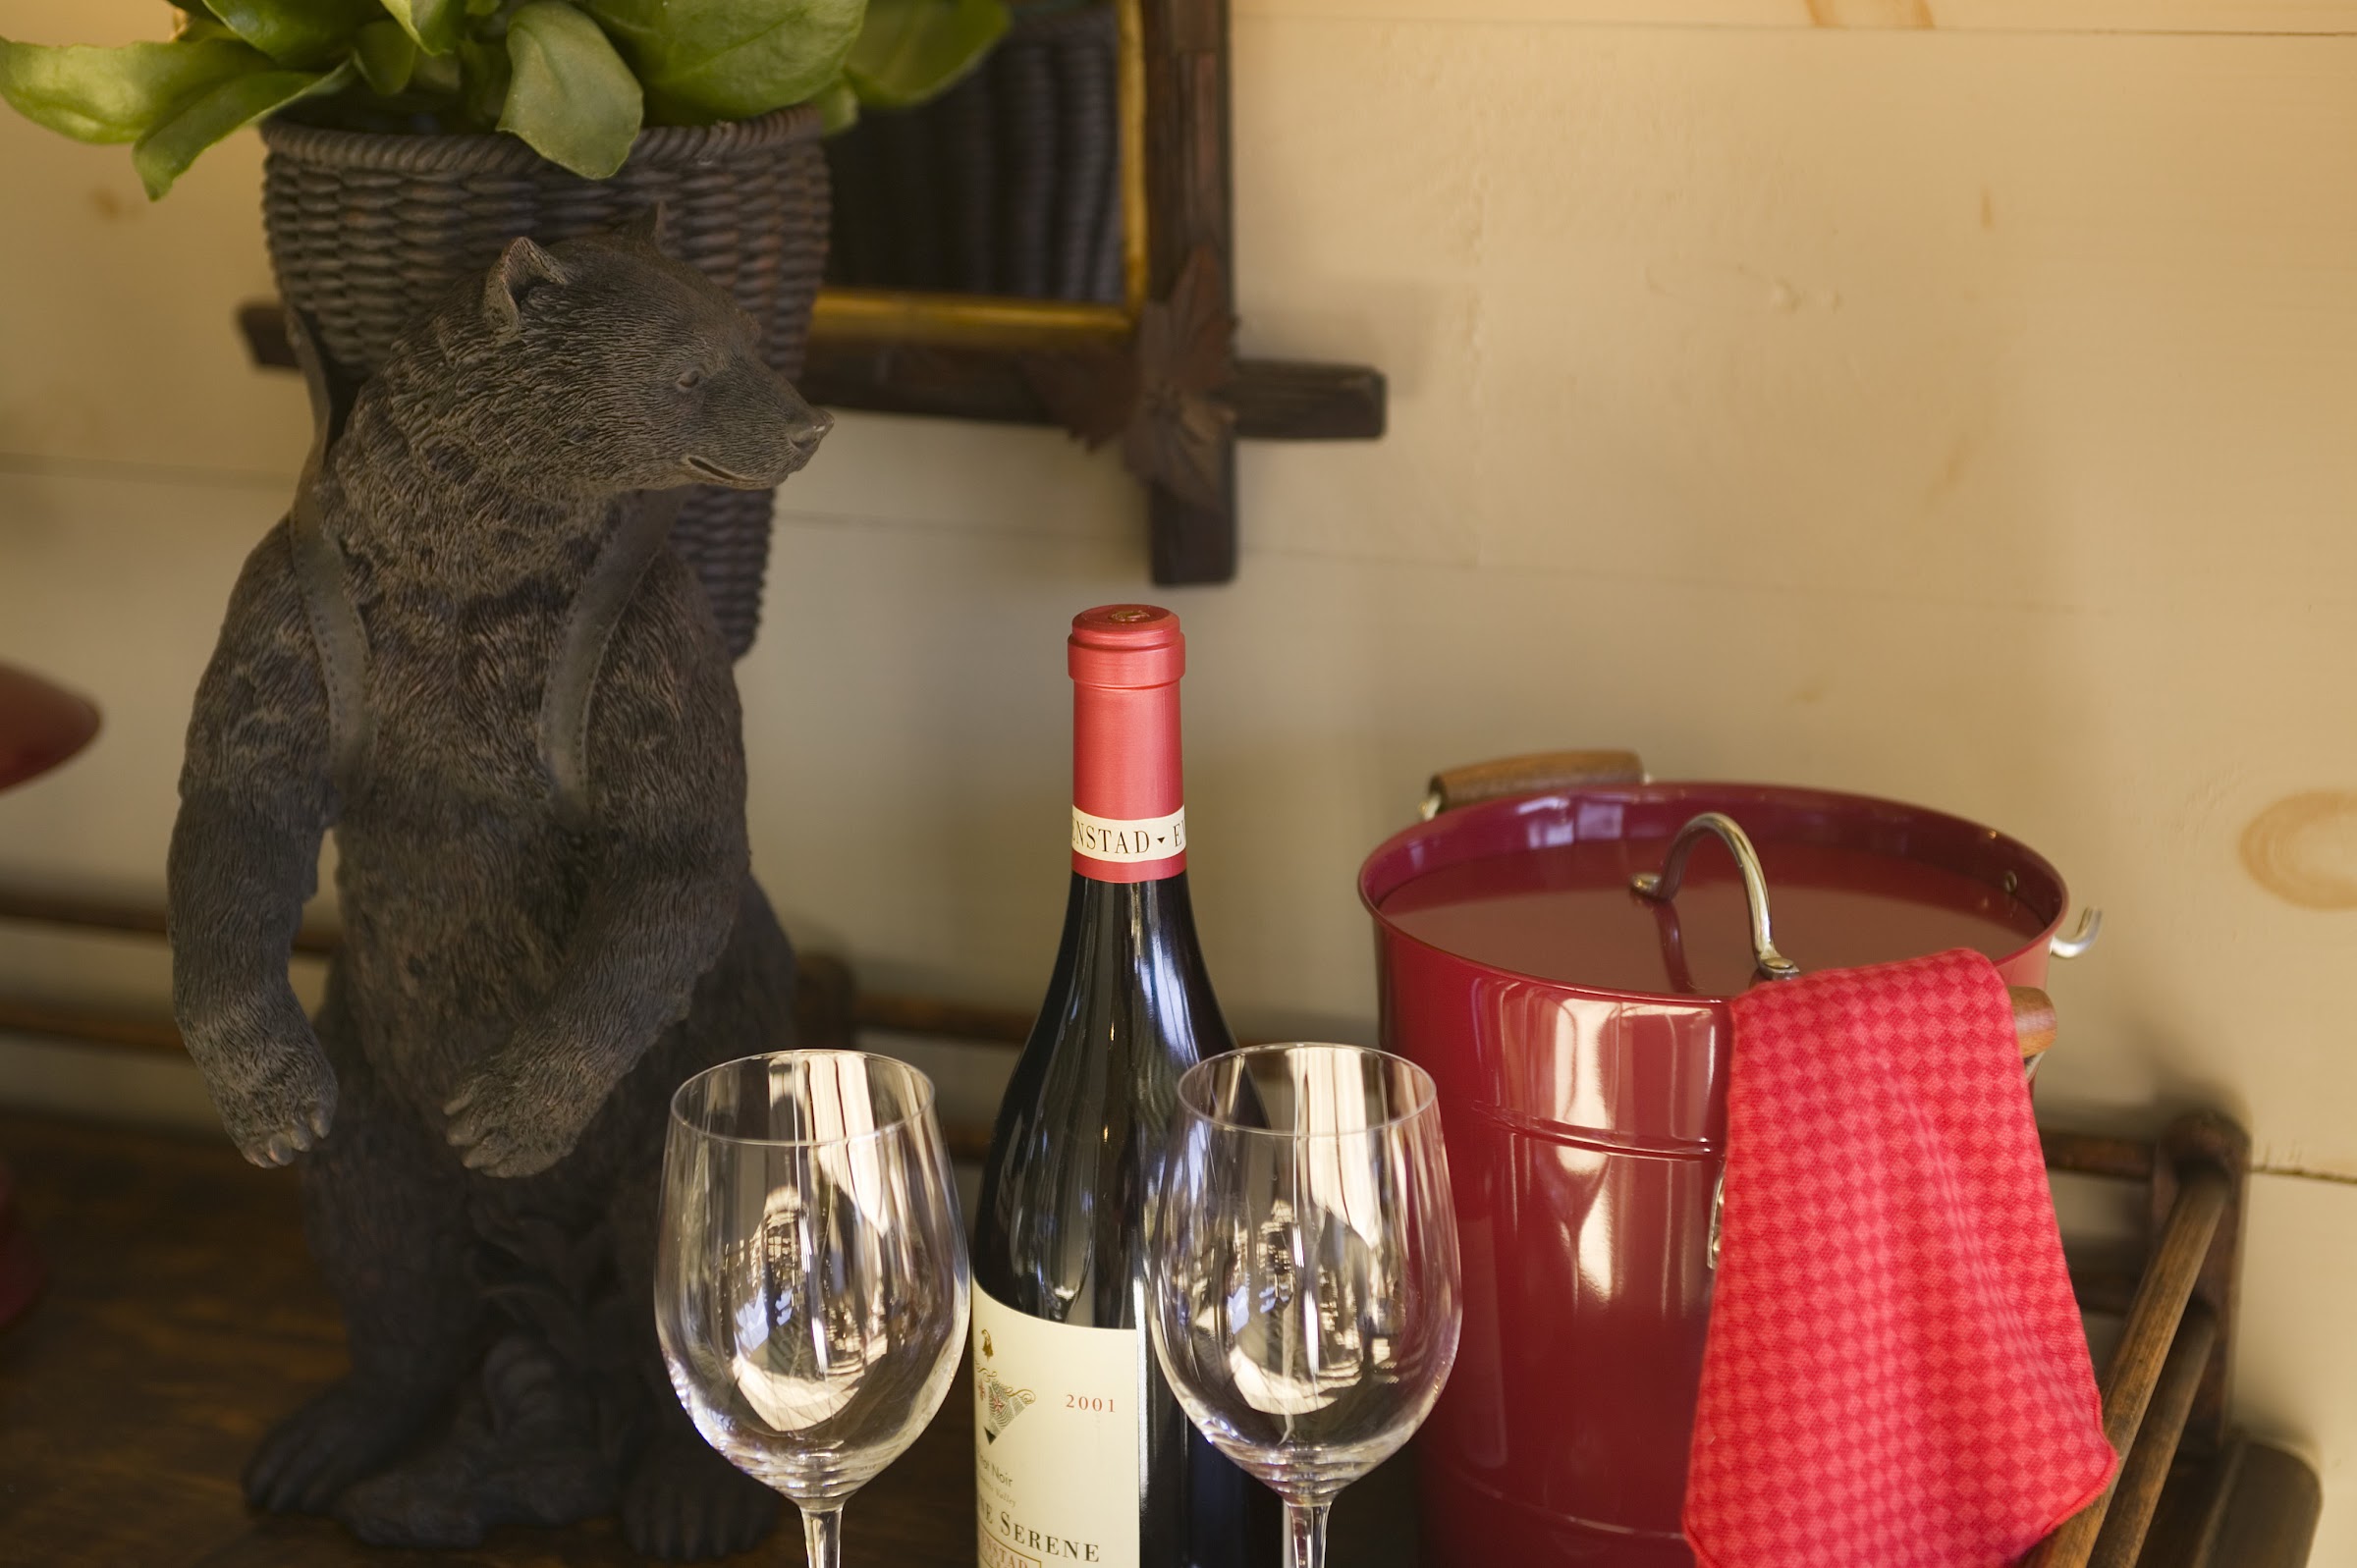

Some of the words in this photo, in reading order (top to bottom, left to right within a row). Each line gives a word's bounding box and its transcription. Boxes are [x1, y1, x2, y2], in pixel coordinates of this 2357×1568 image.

[1066, 1393, 1116, 1413] 2001
[992, 1462, 1013, 1487] Noir
[996, 1487, 1016, 1508] Valley
[1000, 1511, 1100, 1563] SERENE
